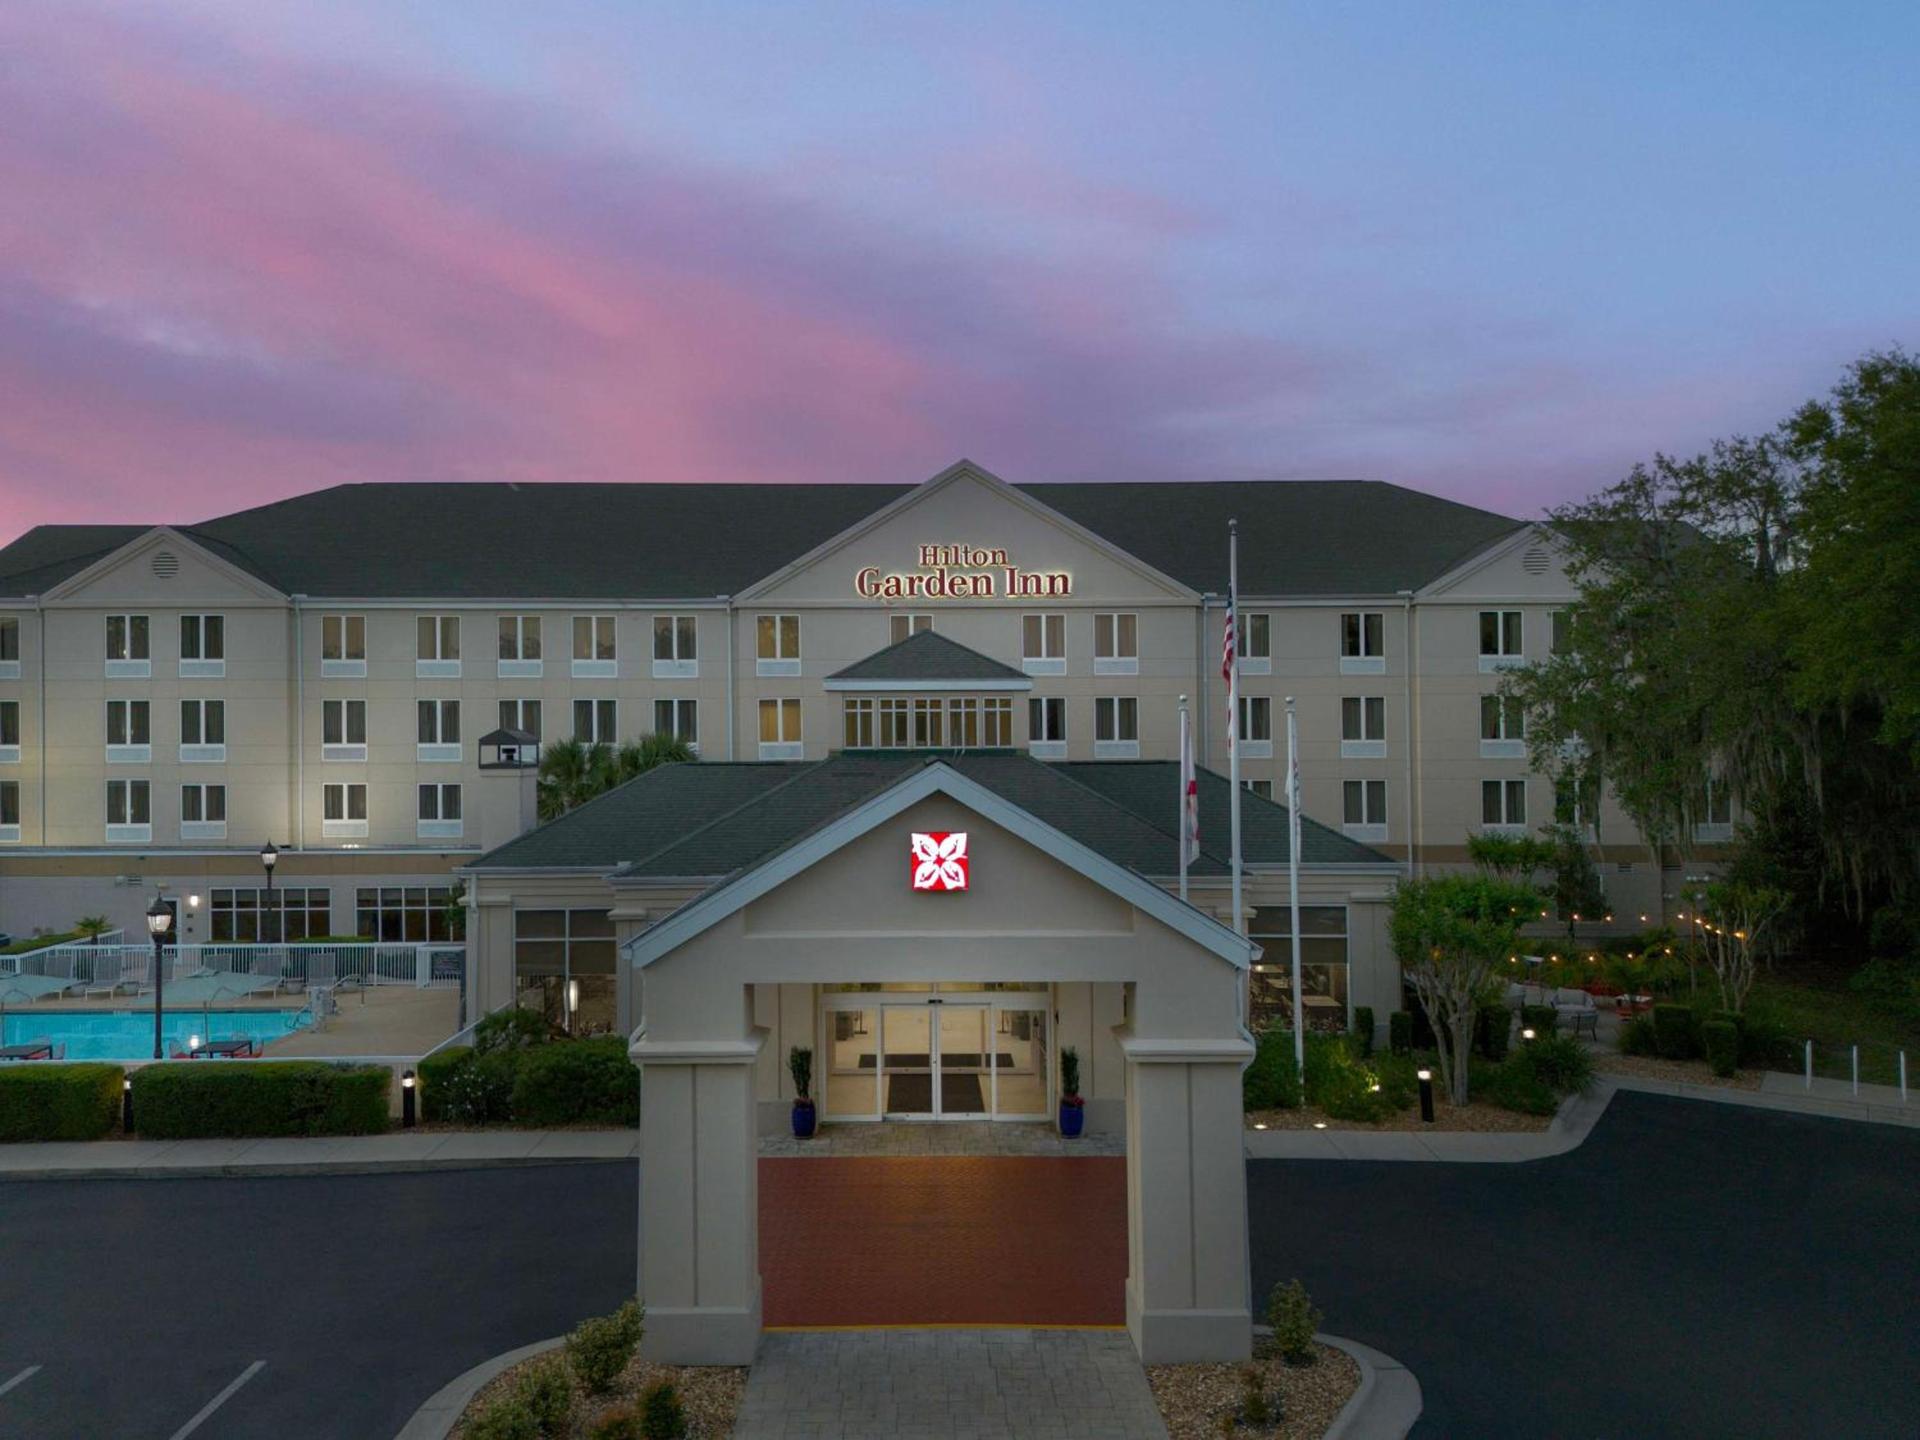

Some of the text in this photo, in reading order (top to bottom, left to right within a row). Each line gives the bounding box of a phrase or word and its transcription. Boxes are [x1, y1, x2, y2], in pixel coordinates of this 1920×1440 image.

[919, 545, 1008, 567] Hilton
[857, 567, 1071, 597] Garden Inn
